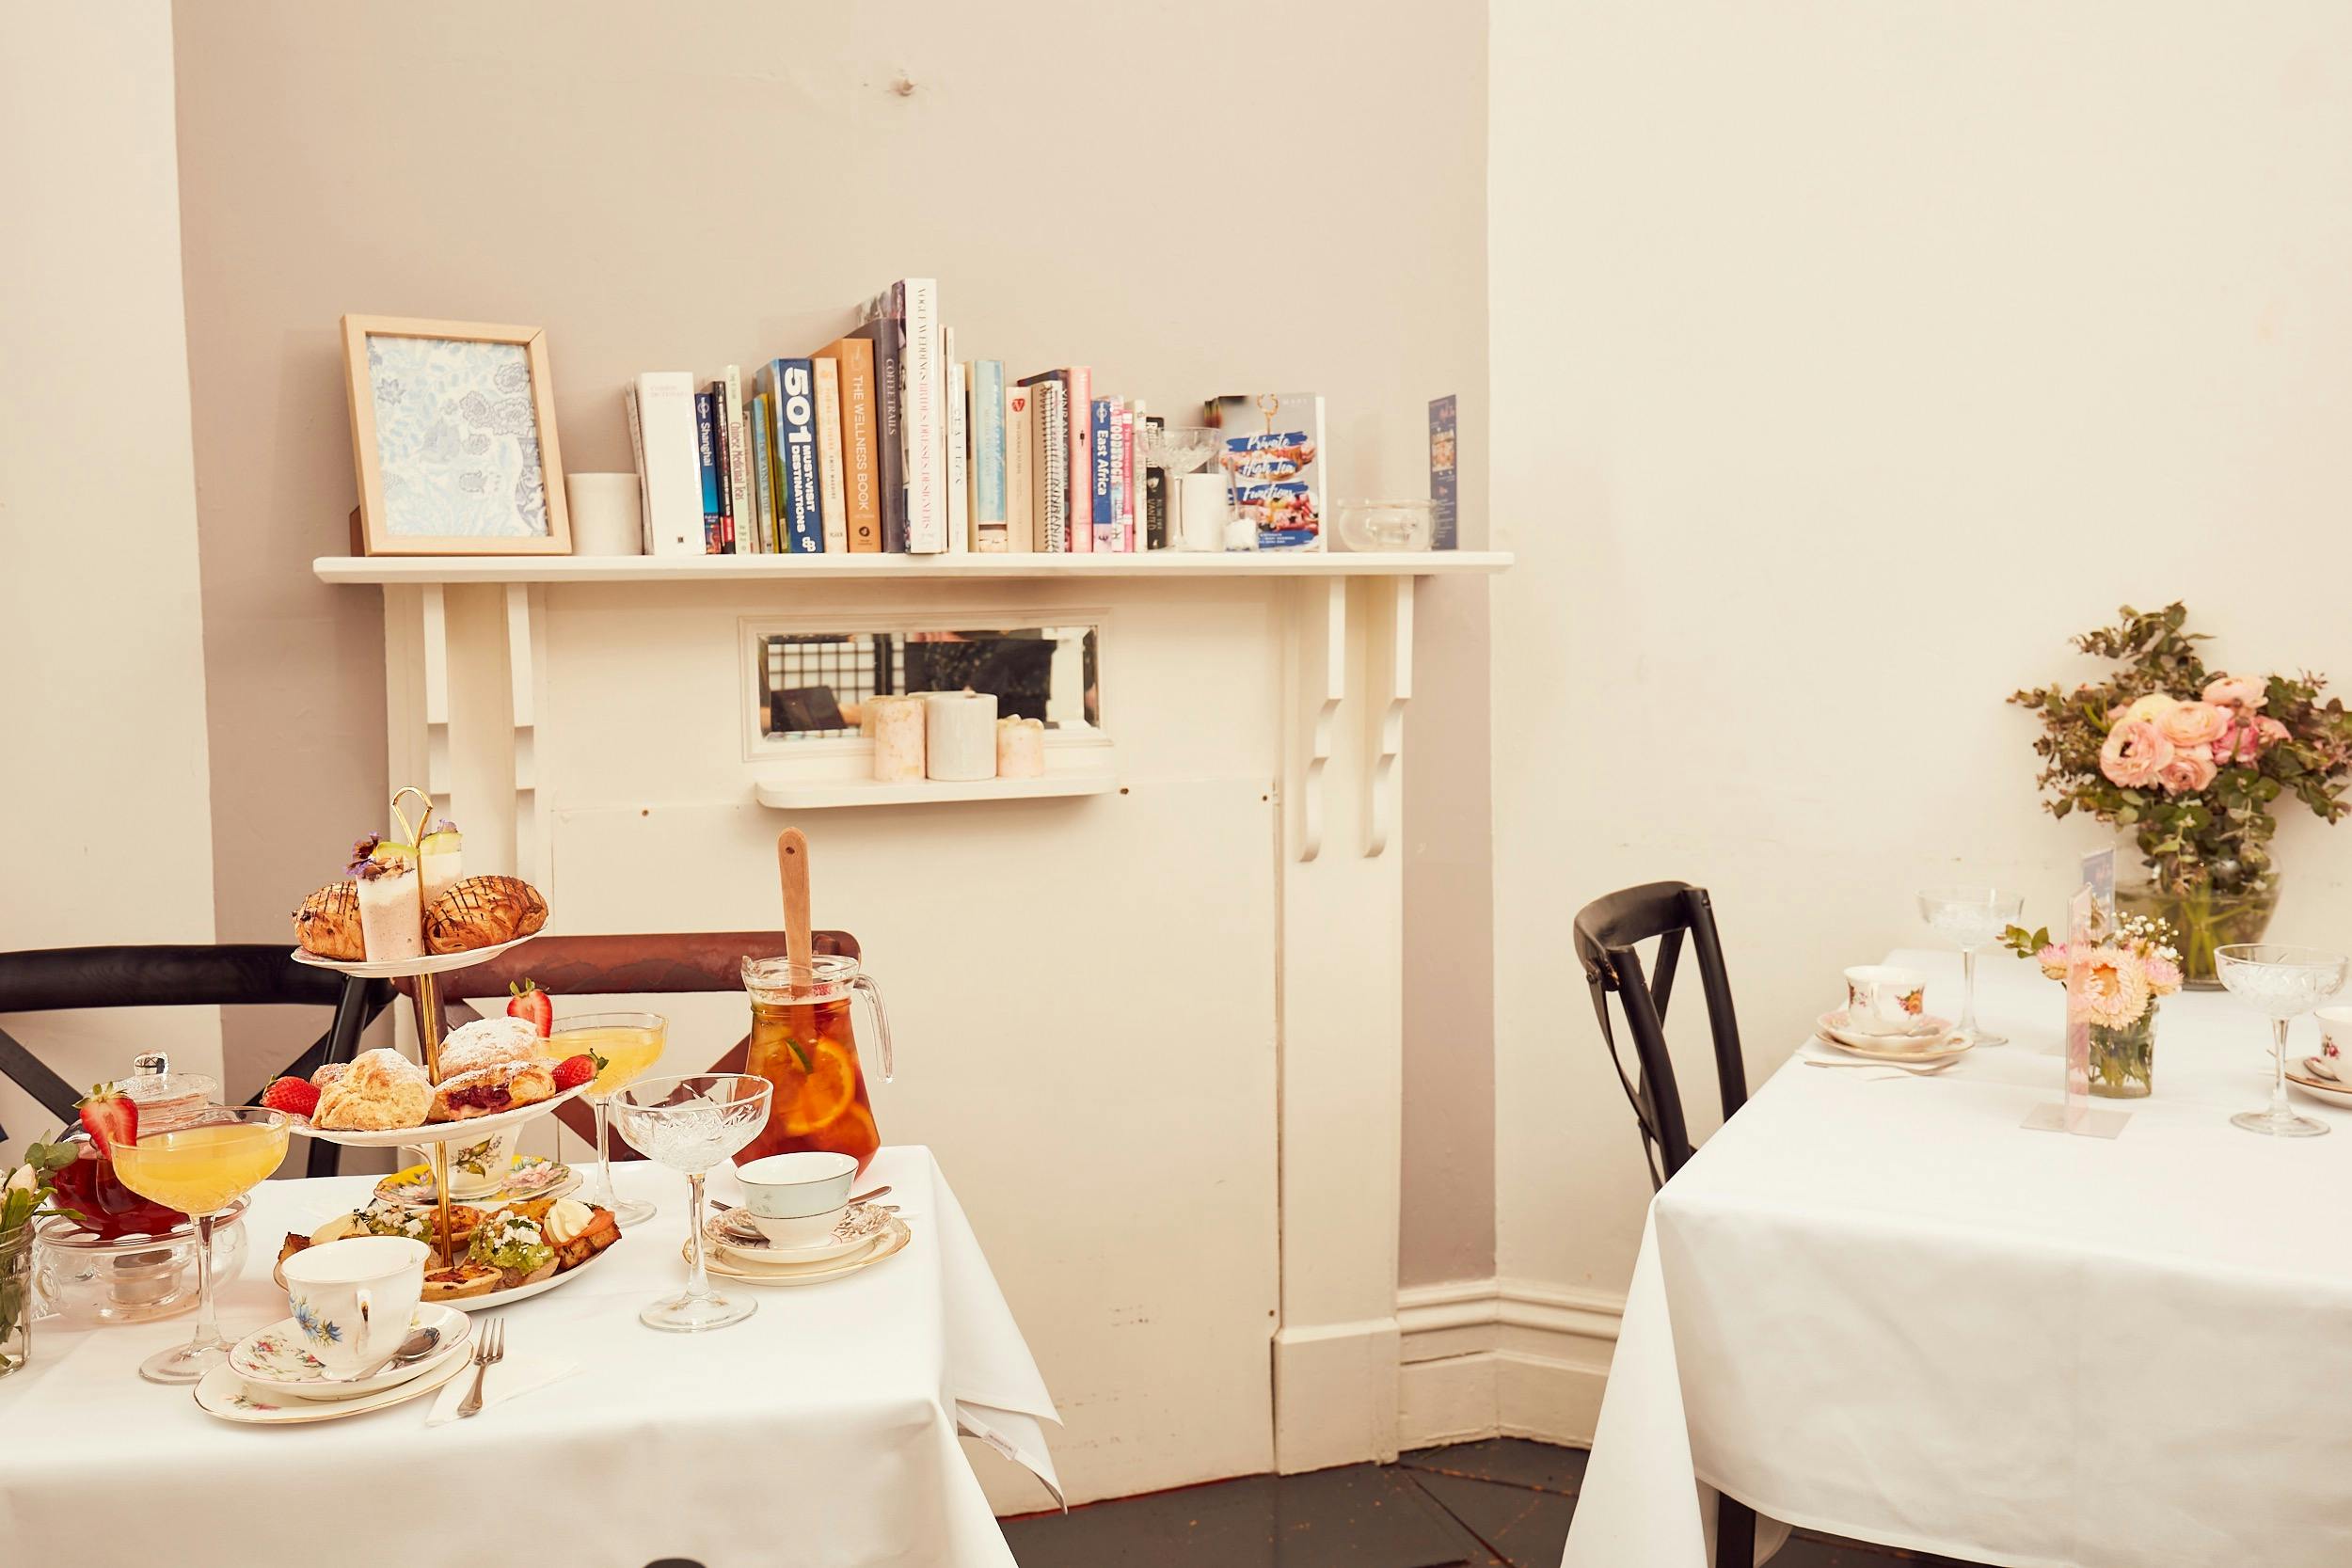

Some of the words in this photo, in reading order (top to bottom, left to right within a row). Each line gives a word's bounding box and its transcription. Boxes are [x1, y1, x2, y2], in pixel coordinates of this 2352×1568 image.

[917, 287, 927, 322] VOGUE
[918, 324, 928, 381] WEDDINGS
[852, 375, 865, 400] THE
[886, 357, 896, 398] COFFEE
[784, 367, 812, 443] 501
[887, 399, 897, 436] TRAILS
[700, 422, 713, 467] Shanghai
[730, 421, 742, 449] Chinese
[854, 404, 867, 470] WELLNESS
[1097, 430, 1108, 456] East
[1110, 415, 1123, 483] WOODSTOCK
[1247, 433, 1290, 451] Private
[732, 449, 746, 484] Medicinal
[803, 445, 816, 513] MUST-VISIT
[1098, 459, 1109, 496] Africa
[1243, 461, 1271, 477] High
[1273, 462, 1296, 474] Tea
[735, 485, 746, 500] Teas
[791, 445, 806, 533] DESTINATIONS
[857, 474, 869, 511] BOOK
[1243, 483, 1295, 501] Functions
[1148, 499, 1156, 531] WANTED
